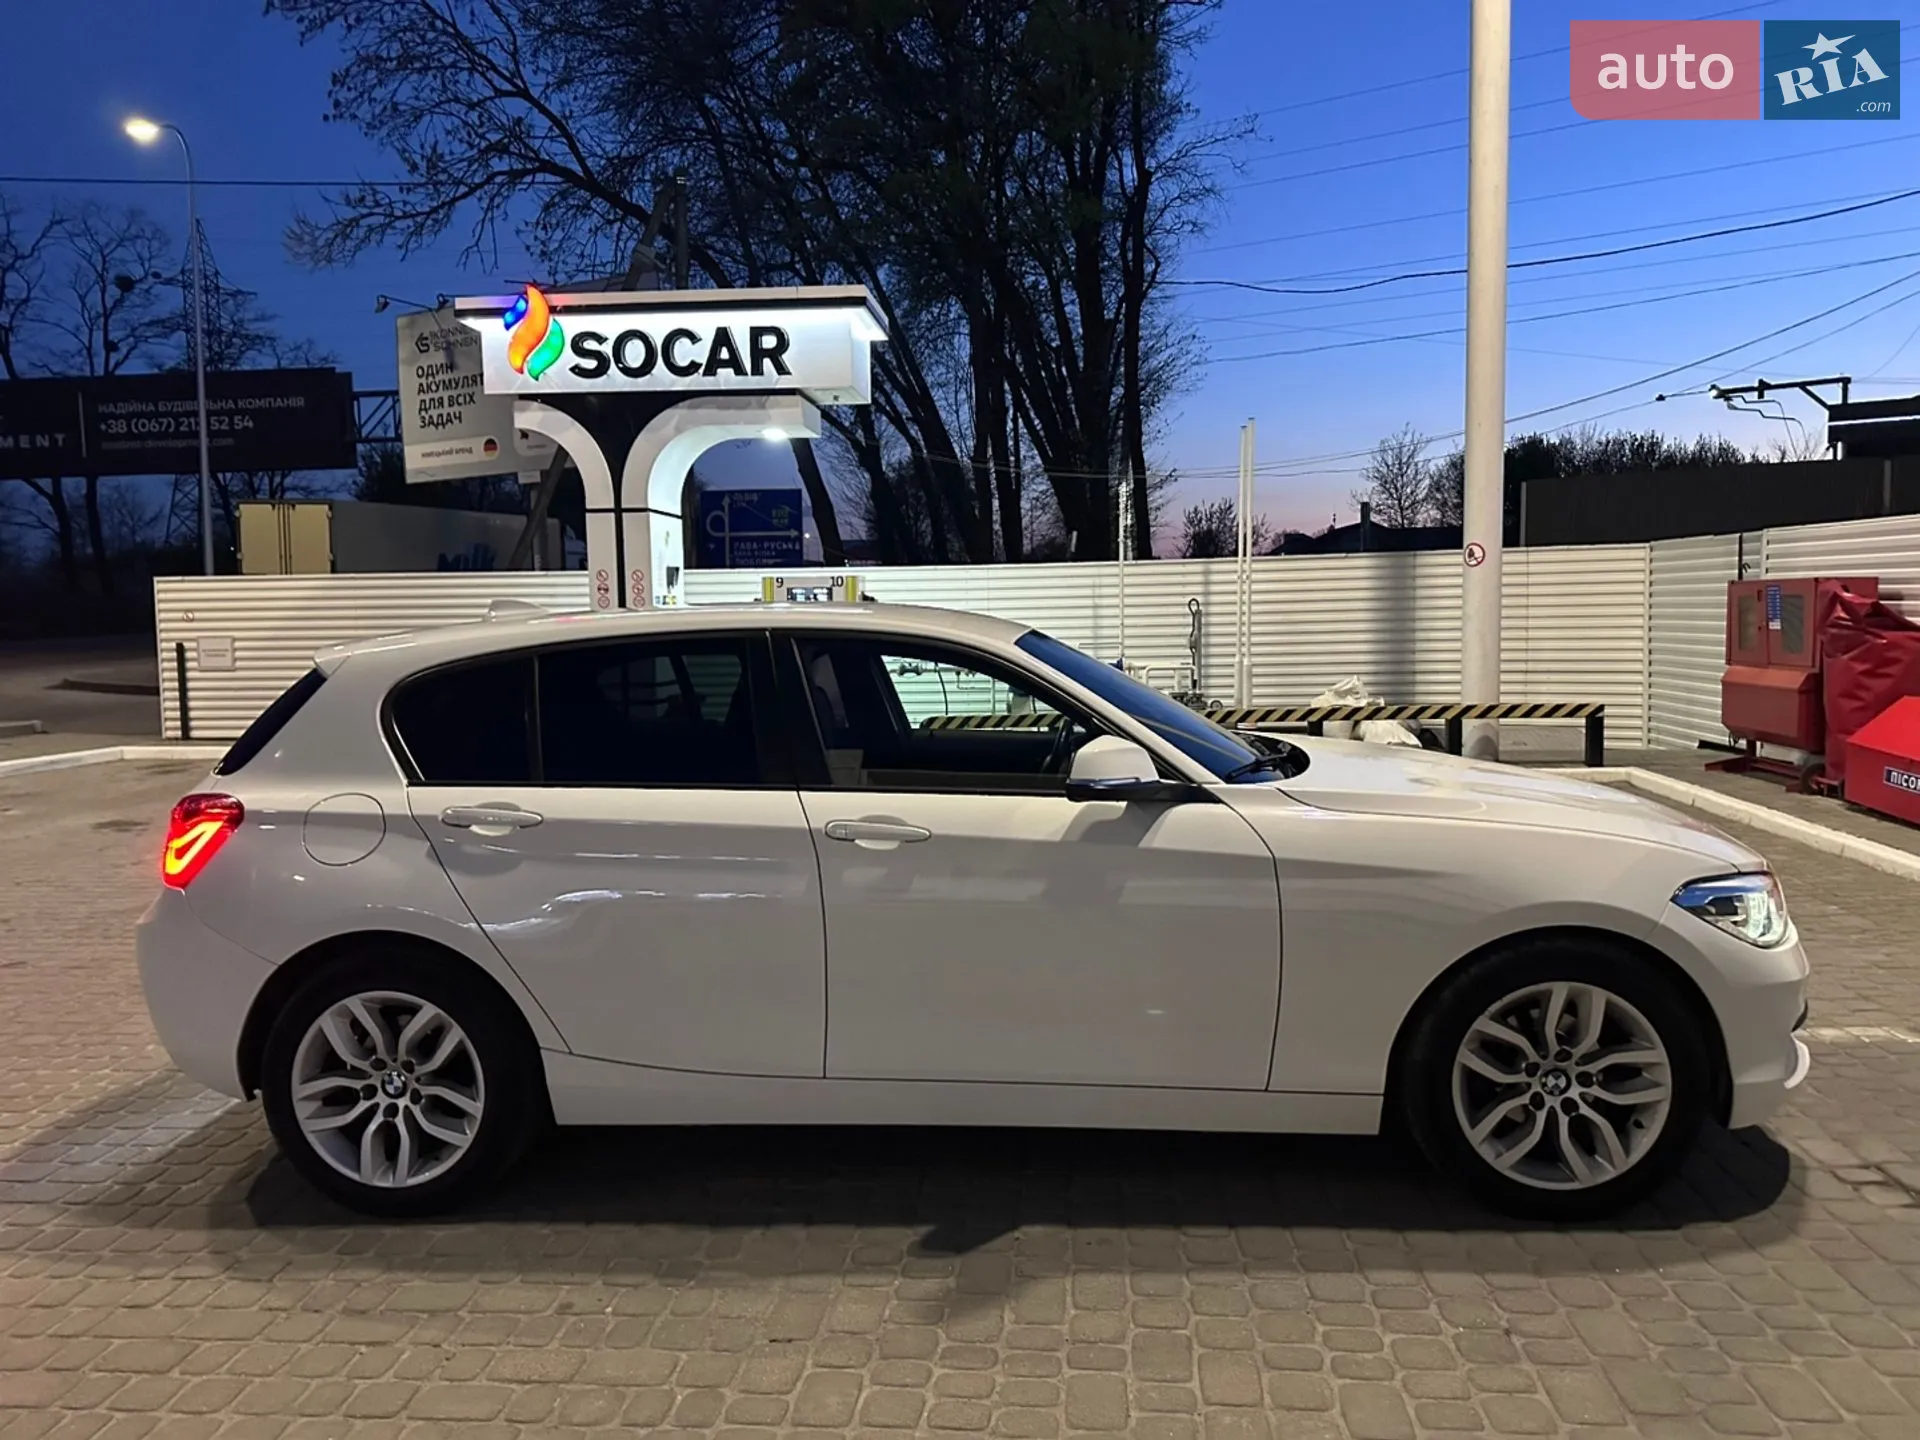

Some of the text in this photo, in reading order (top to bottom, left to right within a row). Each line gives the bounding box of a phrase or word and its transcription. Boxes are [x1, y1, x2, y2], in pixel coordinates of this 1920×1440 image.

[569, 326, 791, 379] SOCAR
[416, 362, 454, 380] ОДИН
[238, 396, 305, 409] КОМПАНІЯ
[418, 392, 476, 415] ДЛЯ ВСІХ
[99, 419, 127, 434] +38
[131, 417, 174, 433] (067)
[210, 416, 229, 430] 52
[233, 415, 254, 430] 54
[419, 411, 463, 430] ЗАДАЧ
[776, 576, 844, 588] 9 10
